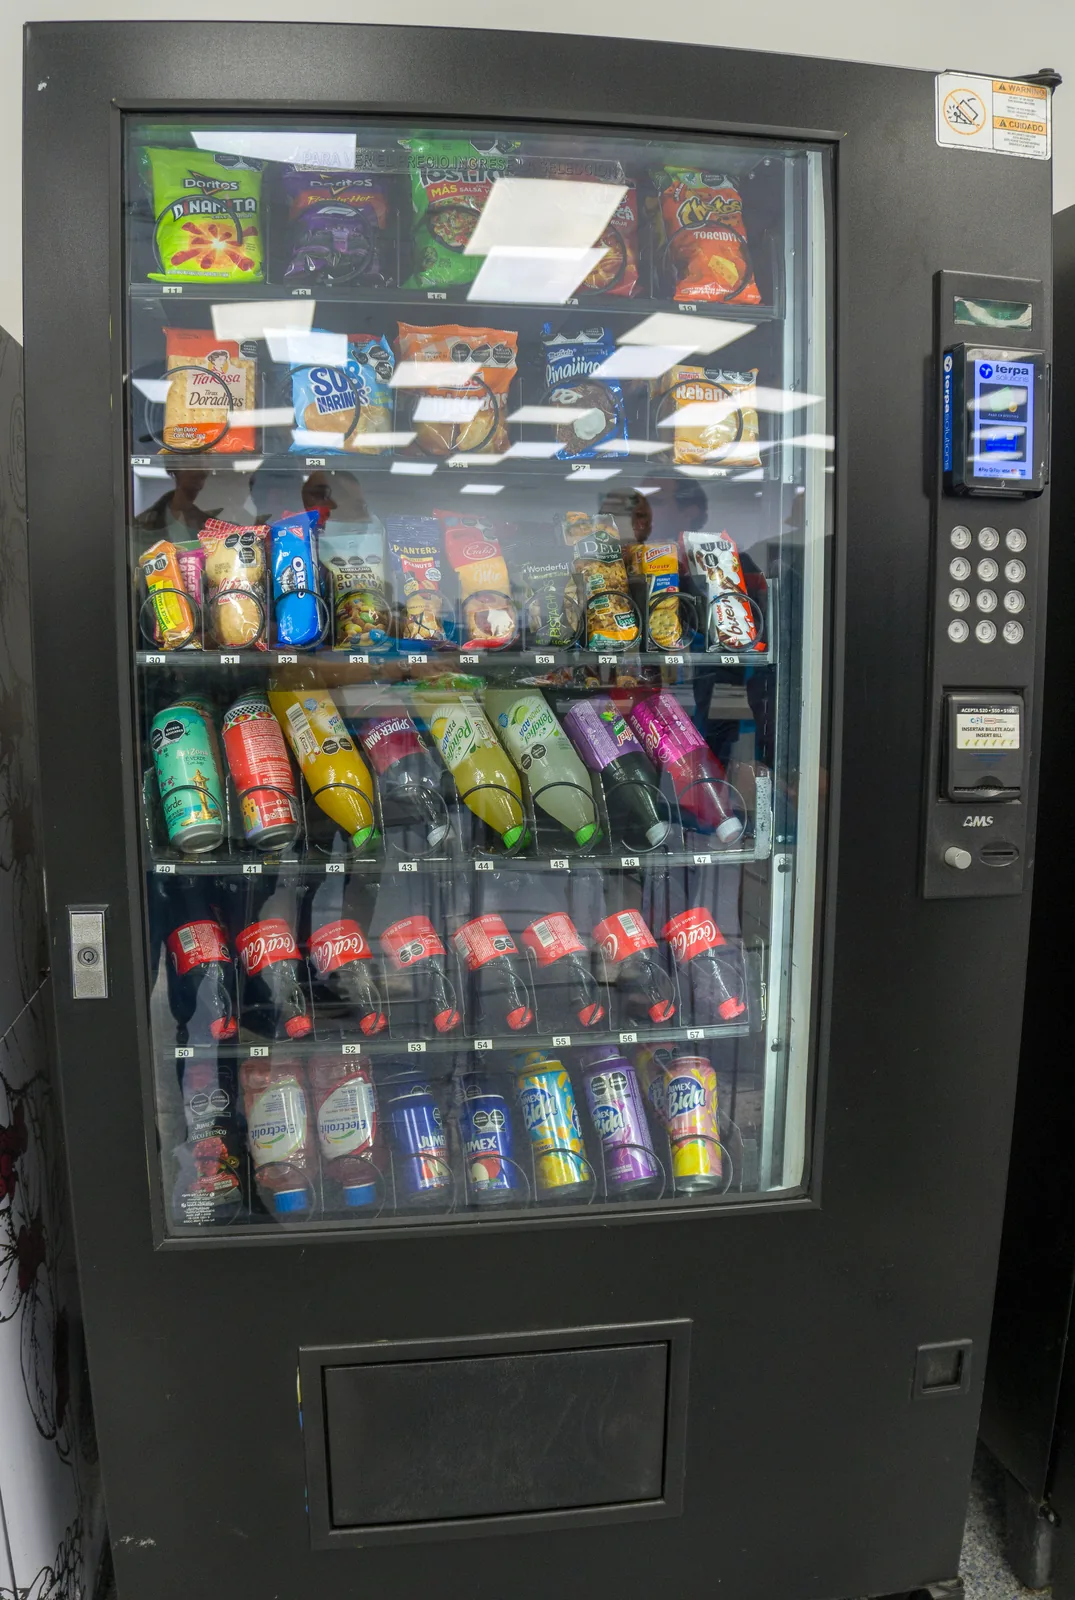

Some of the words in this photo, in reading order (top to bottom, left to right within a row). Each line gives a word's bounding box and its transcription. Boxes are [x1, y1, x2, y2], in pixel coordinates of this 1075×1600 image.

[1008, 84, 1045, 97] WARNING
[1009, 121, 1044, 133] CUIDADO
[184, 178, 238, 190] Doritos
[310, 178, 373, 187] Doritos
[431, 184, 458, 198] MÁS
[995, 364, 1029, 376] terpa
[189, 391, 244, 408] Doraditas
[527, 562, 569, 573] Wonderful
[292, 555, 306, 599] OREO
[149, 656, 161, 664] 30
[224, 656, 235, 664] 31
[281, 656, 293, 664] 32
[352, 656, 364, 664] 33
[411, 655, 422, 663] 34
[462, 656, 474, 664] 35
[631, 715, 646, 741] FRESA
[364, 717, 410, 750] SPIDER-MAN
[963, 816, 994, 827] AMS
[553, 860, 565, 868] 45
[624, 858, 635, 867] 46
[696, 856, 707, 864] 47
[158, 865, 171, 873] 40
[246, 865, 257, 873] 41
[328, 865, 340, 873] 42
[622, 1034, 633, 1042] 56
[178, 1049, 190, 1057] 50
[253, 1048, 264, 1056] 51
[668, 1085, 706, 1120] Bida
[320, 1119, 367, 1136] Electrolit
